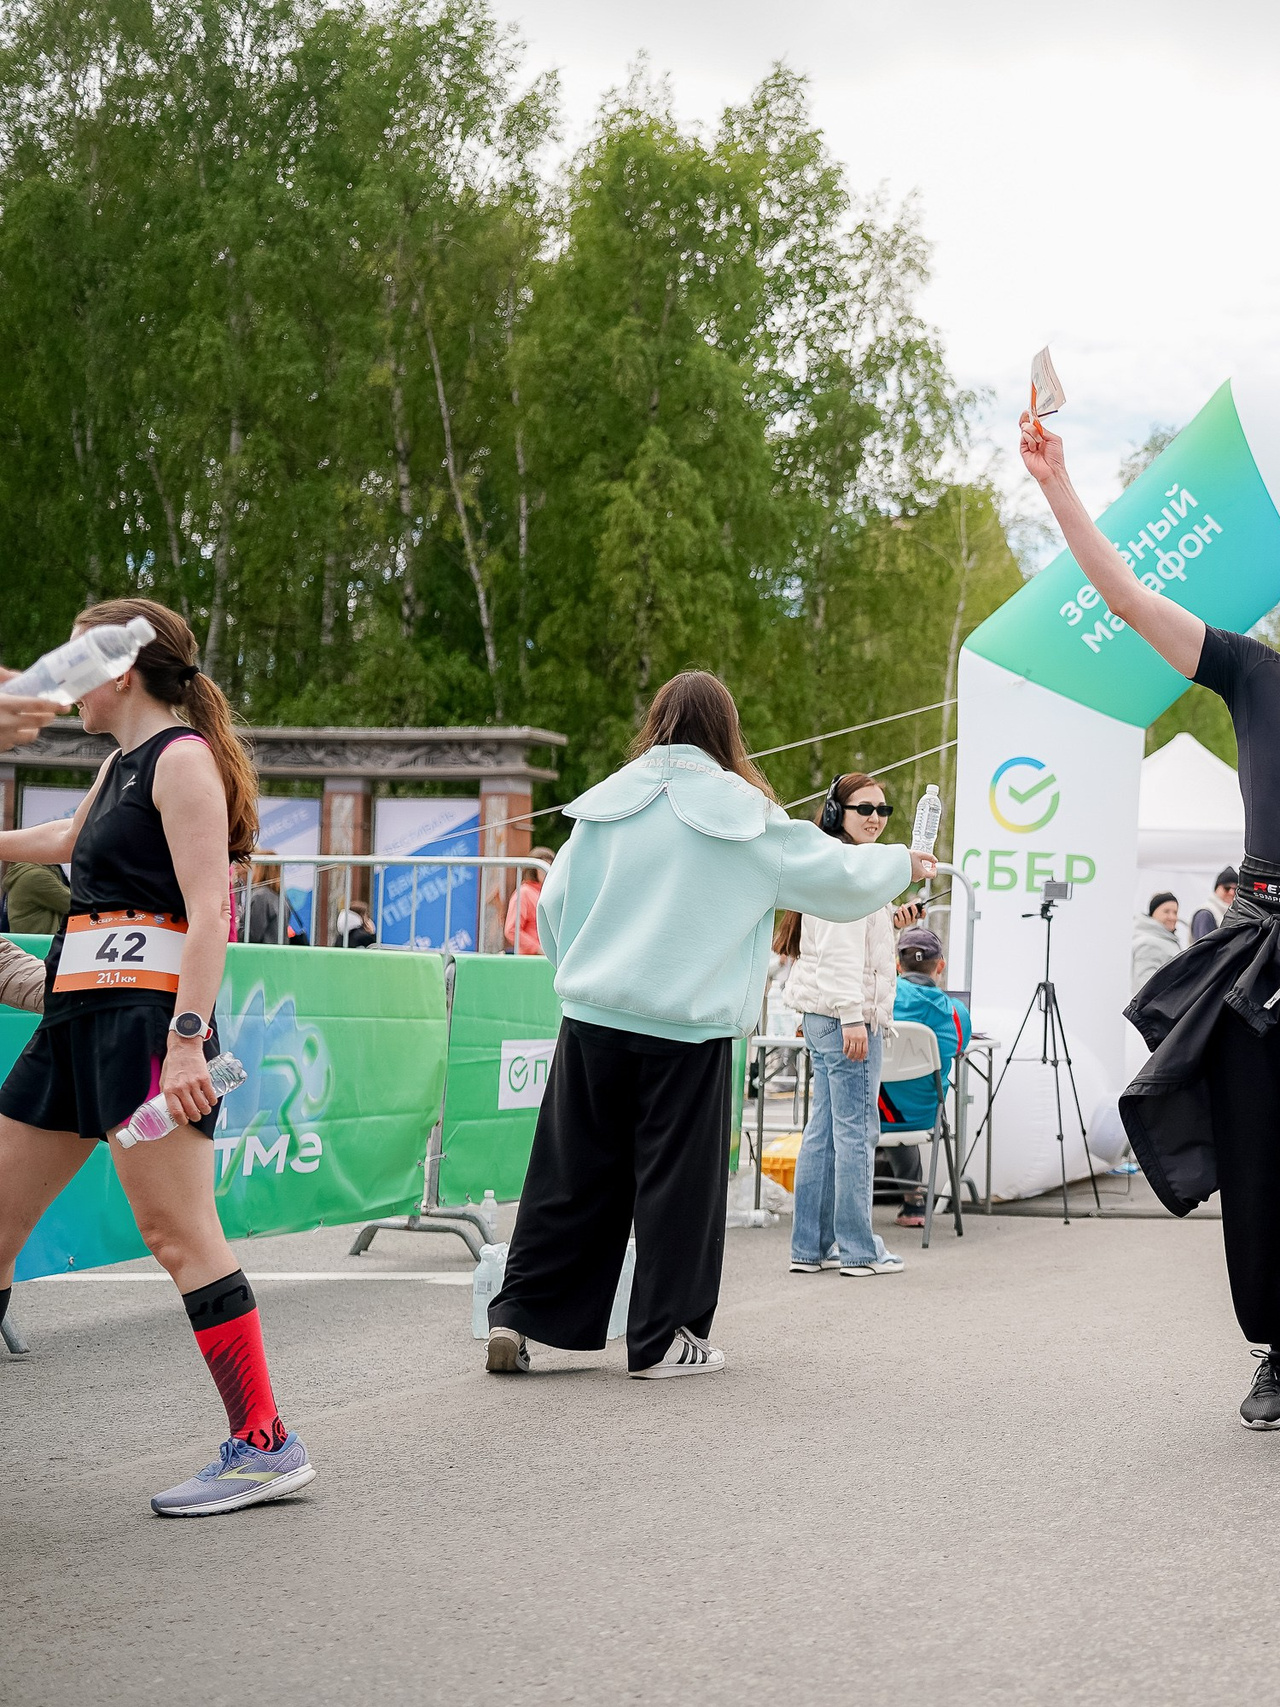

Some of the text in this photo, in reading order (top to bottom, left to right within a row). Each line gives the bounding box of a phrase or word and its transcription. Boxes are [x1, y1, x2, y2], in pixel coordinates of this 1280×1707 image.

[1059, 483, 1199, 627] зеный
[1081, 514, 1223, 653] маафон
[962, 848, 1097, 893] СБЕР
[95, 932, 147, 962] 42
